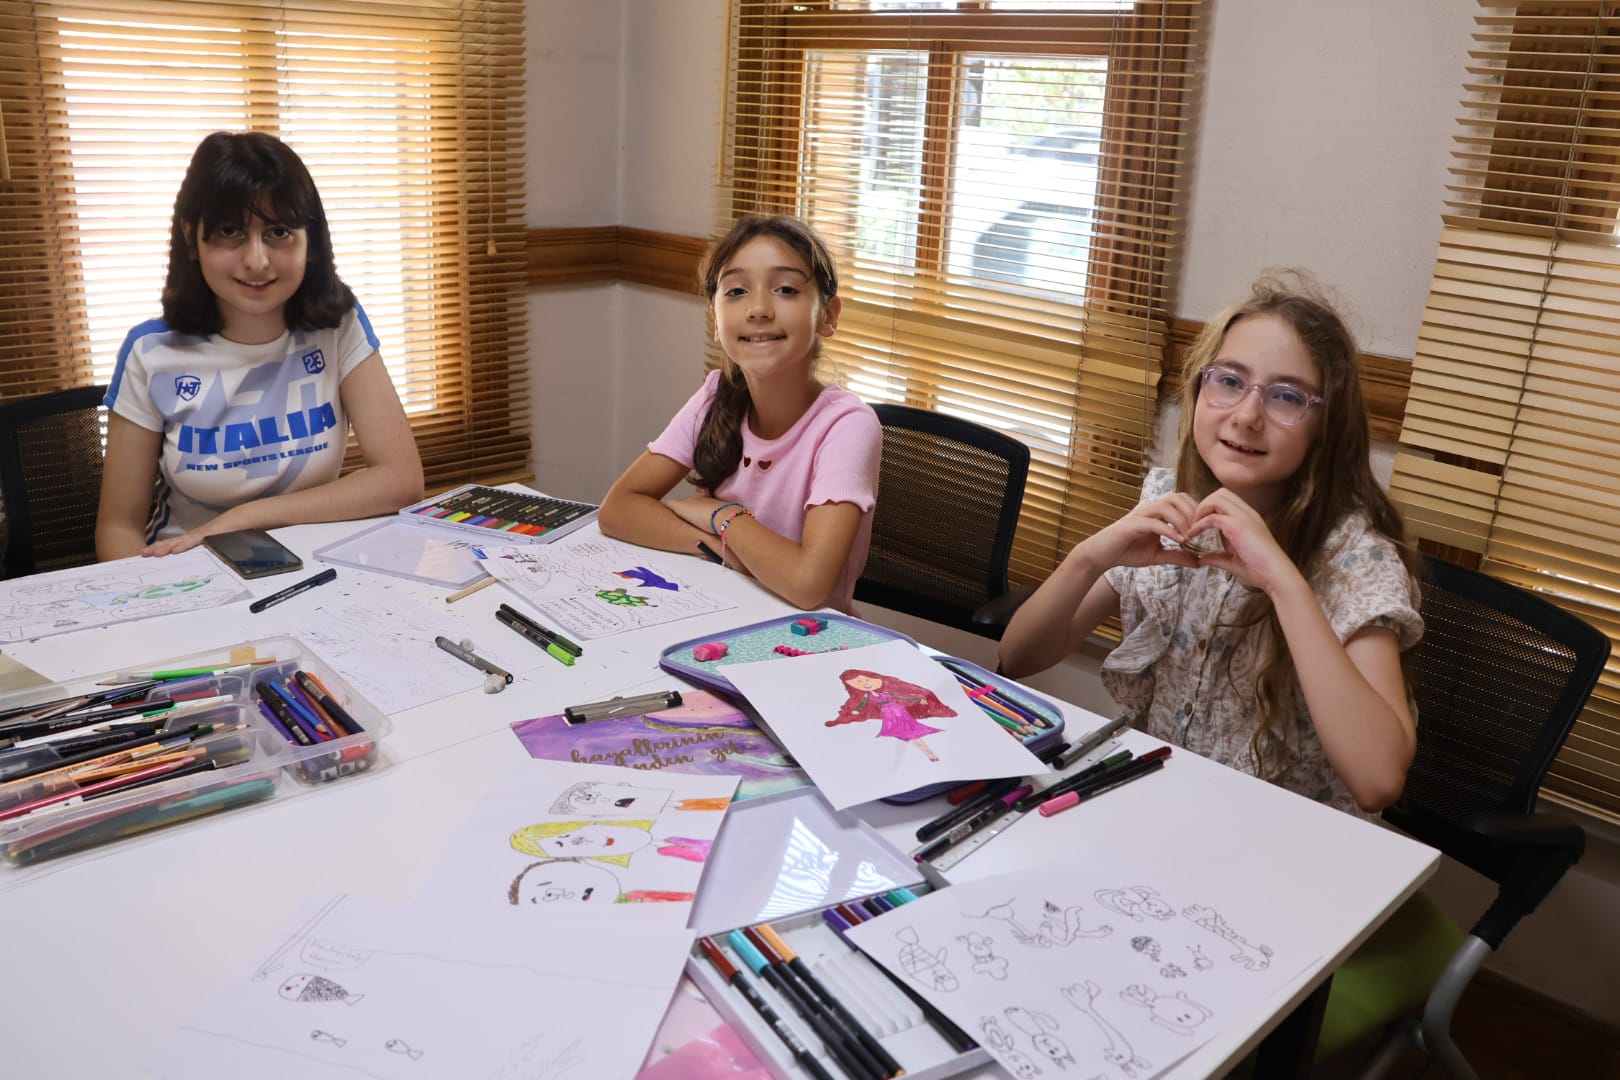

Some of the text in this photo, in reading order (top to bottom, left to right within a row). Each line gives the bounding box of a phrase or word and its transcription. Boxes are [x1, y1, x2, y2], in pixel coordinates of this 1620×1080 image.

[305, 352, 323, 371] 23
[178, 402, 336, 455] ITALIA
[186, 463, 218, 471] NEW
[223, 454, 277, 469] SPORTS
